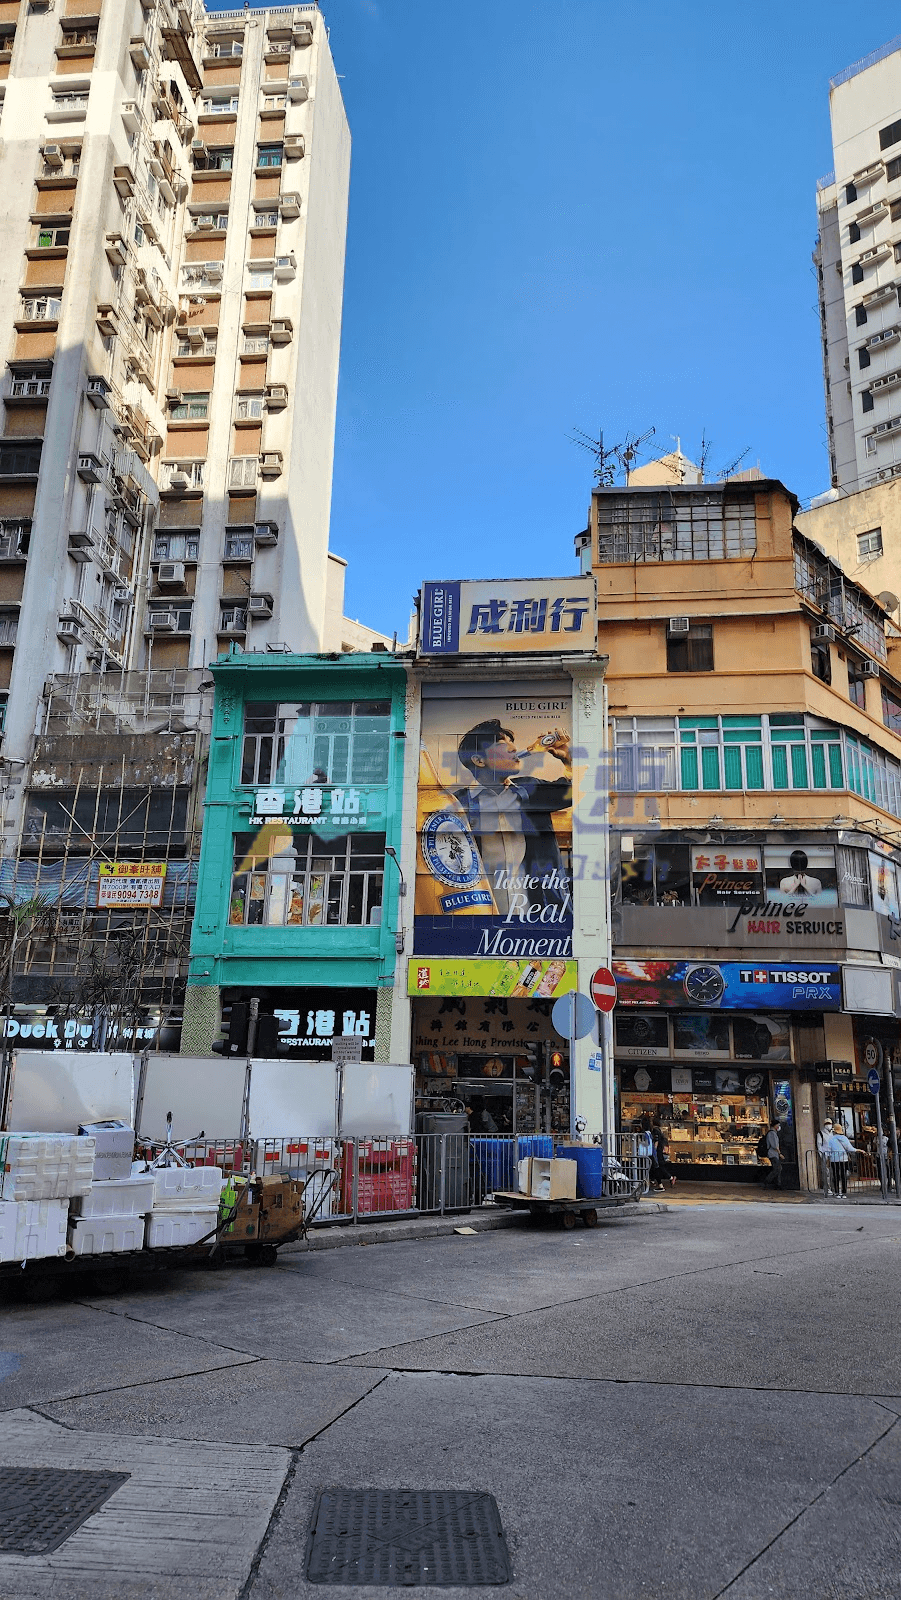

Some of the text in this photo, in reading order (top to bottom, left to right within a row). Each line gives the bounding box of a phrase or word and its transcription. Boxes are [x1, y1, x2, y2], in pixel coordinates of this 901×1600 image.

[432, 588, 442, 648] BLUE GIRL
[466, 597, 589, 635] 成利行
[506, 702, 567, 712] BLUE GIRL
[255, 788, 361, 814] 香港站
[248, 816, 328, 826] HK RESTAURANT
[494, 869, 540, 890] Taste
[541, 868, 570, 890] the
[698, 873, 754, 894] Prince
[117, 891, 137, 899] 9094
[445, 893, 492, 907] BLUE GIRL
[502, 893, 570, 924] Real
[747, 921, 843, 935] HAIR SERVICE
[474, 928, 574, 956] Moment
[770, 972, 831, 984] TISSOT
[792, 987, 833, 1000] PRX
[2, 1019, 58, 1038] Duck
[416, 1036, 438, 1047] hing
[442, 1037, 459, 1046] Lee
[463, 1037, 487, 1049] Hong
[866, 1050, 876, 1060] 50
